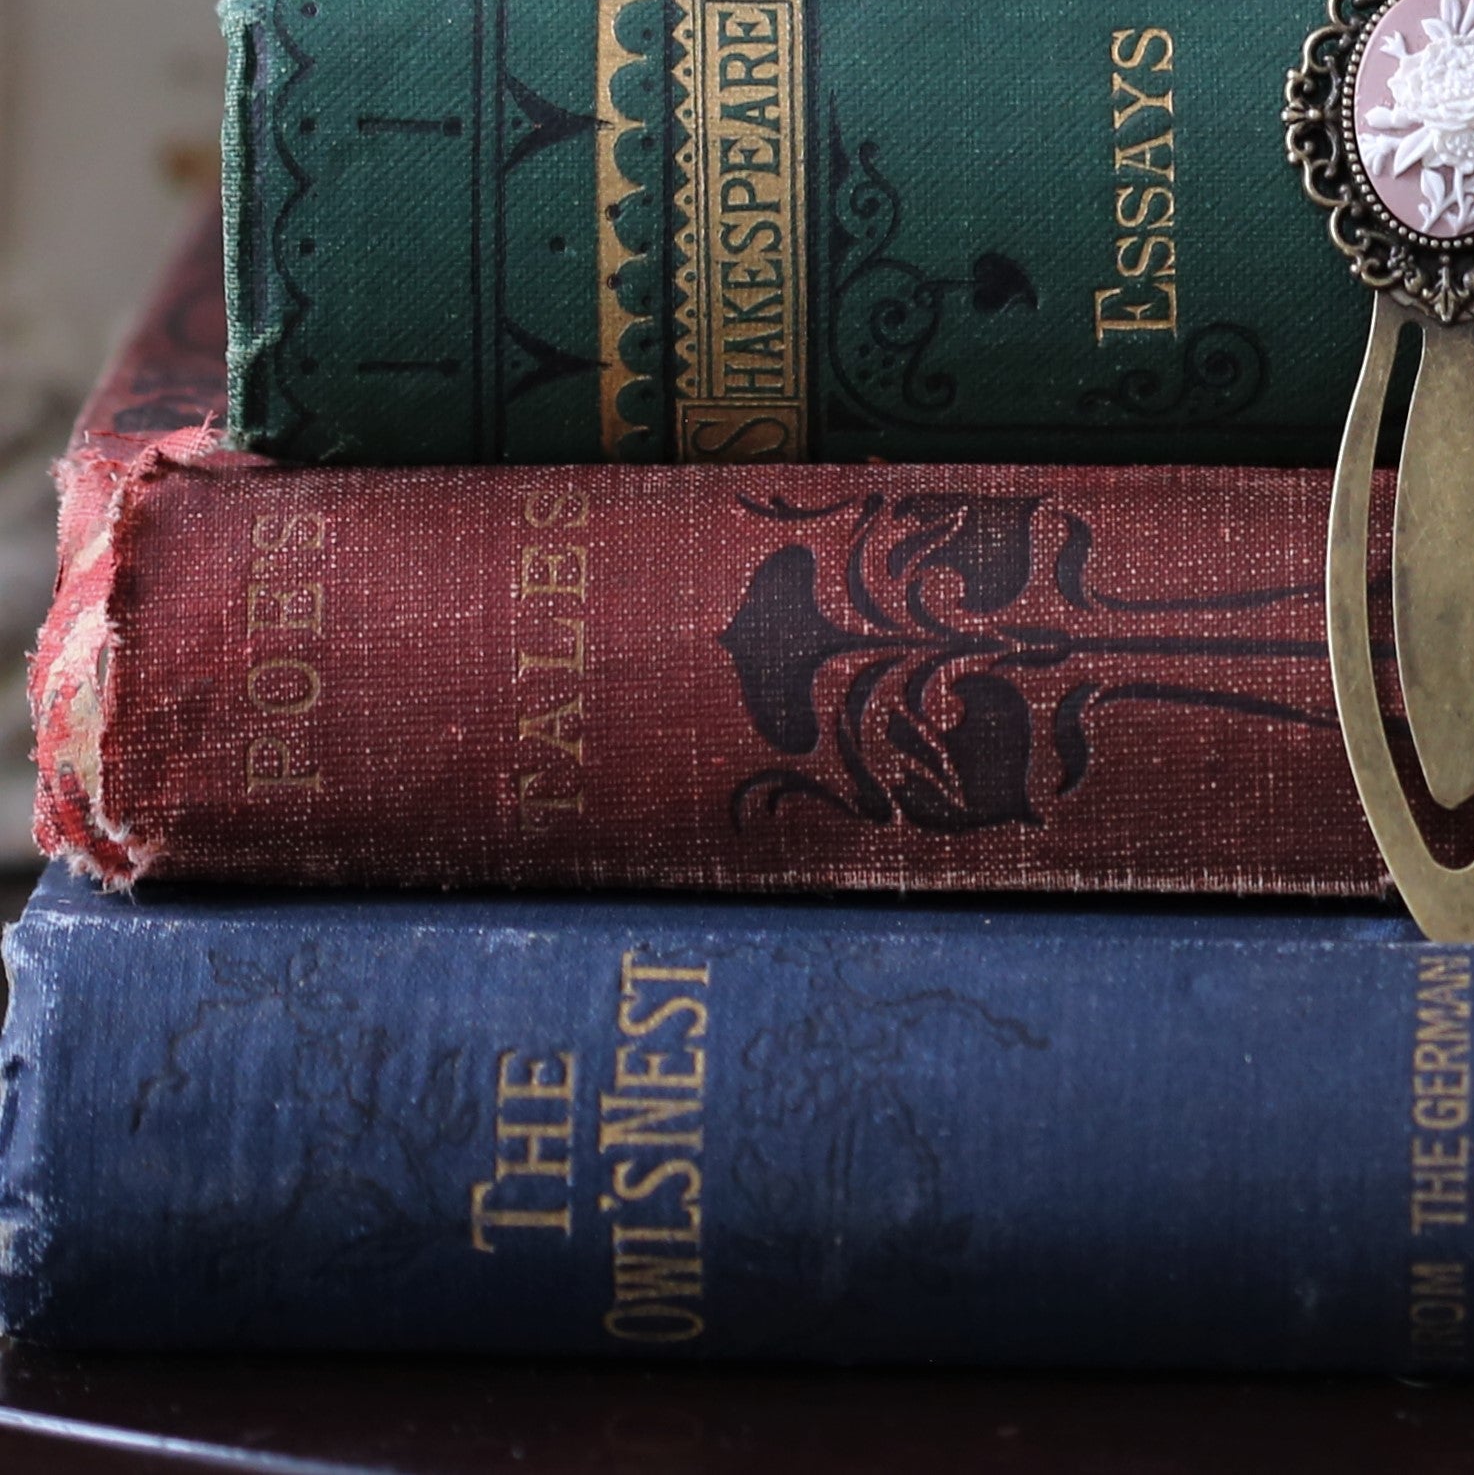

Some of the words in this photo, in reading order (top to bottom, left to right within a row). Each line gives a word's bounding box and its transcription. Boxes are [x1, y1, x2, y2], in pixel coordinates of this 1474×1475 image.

[690, 6, 788, 463] SHAKESPEARE
[1094, 27, 1178, 347] ESSAYS
[246, 512, 326, 794] POE'S
[518, 489, 590, 831] TALES
[472, 1049, 575, 1254] THE
[1412, 955, 1472, 1128] GERMAN
[1411, 1136, 1470, 1235] THE
